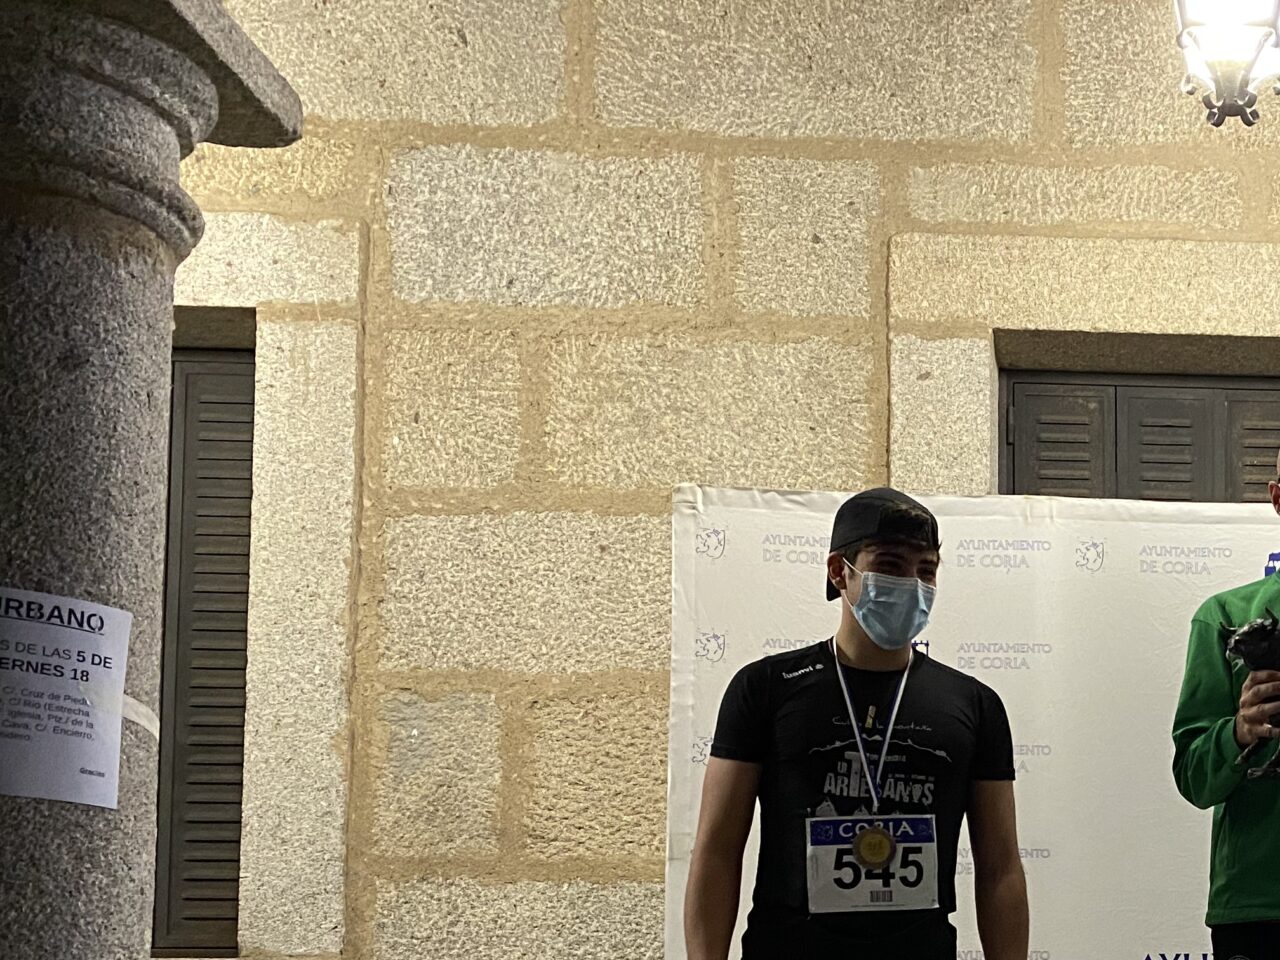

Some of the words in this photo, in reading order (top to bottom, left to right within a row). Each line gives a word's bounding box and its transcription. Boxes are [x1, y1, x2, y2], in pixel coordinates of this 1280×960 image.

[956, 539, 1052, 552] AYUNTAMIENTO
[1140, 545, 1232, 558] AYUNTAMIENTO
[763, 549, 781, 563] DE
[786, 550, 827, 564] CORI
[956, 554, 976, 568] DE
[979, 554, 1030, 569] CORIA
[1140, 560, 1158, 574] DE
[1162, 560, 1211, 575] CORIA
[15, 642, 37, 656] DE
[42, 646, 72, 661] LAS
[76, 650, 86, 663] 5
[91, 653, 113, 670] DE
[956, 643, 1053, 655] AYUNTAMIENTO
[957, 657, 977, 670] DE
[979, 657, 1030, 670] CORIA
[70, 668, 89, 682] 18
